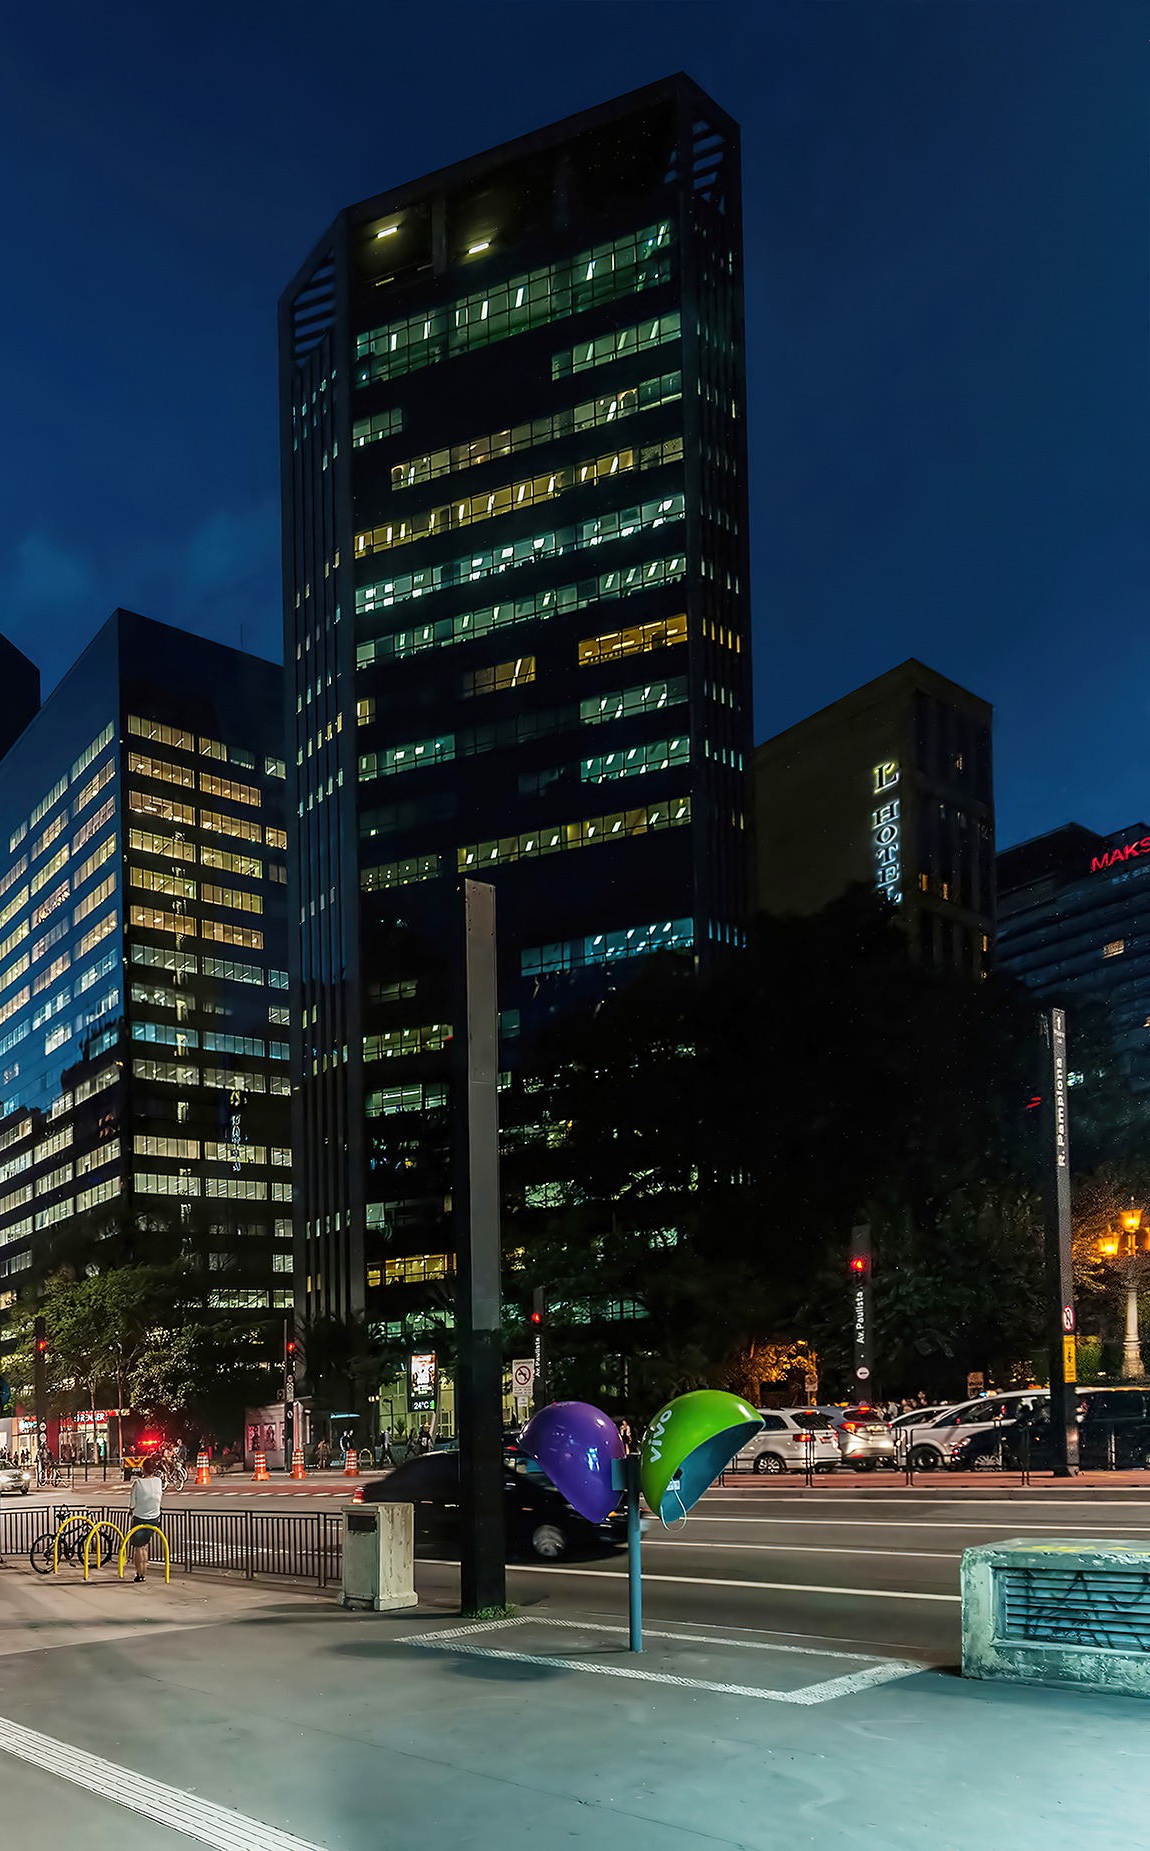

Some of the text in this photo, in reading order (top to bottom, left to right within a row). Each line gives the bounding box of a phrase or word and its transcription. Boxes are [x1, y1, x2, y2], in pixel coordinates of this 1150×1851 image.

[1056, 1056, 1067, 1148] Pamplona
[855, 1291, 865, 1330] Paulista
[647, 1408, 674, 1464] vivo
